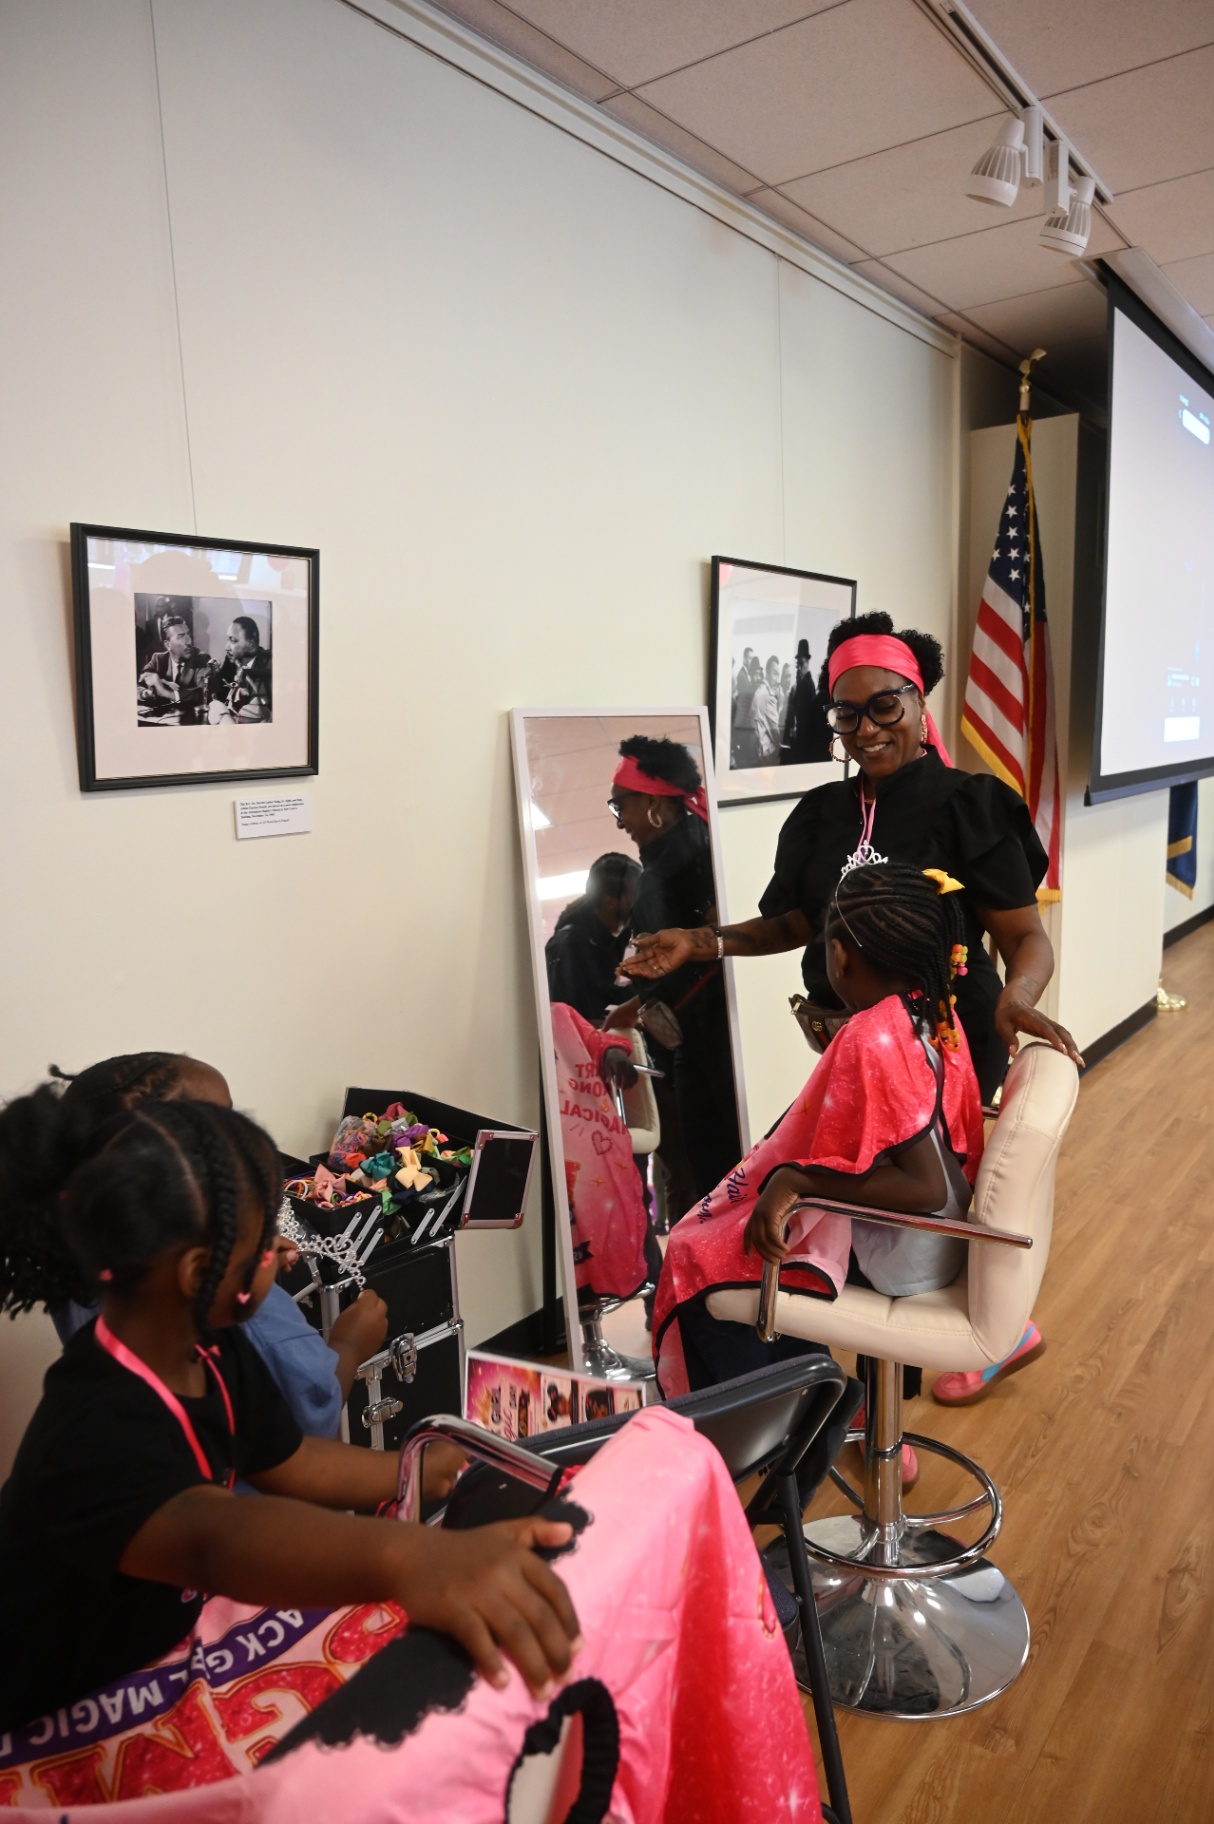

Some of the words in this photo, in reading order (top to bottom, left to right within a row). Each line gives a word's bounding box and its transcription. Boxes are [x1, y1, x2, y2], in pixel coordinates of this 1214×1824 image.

[726, 1167, 749, 1204] Hair
[235, 1608, 304, 1662] ACK
[28, 1679, 165, 1746] MAGIC
